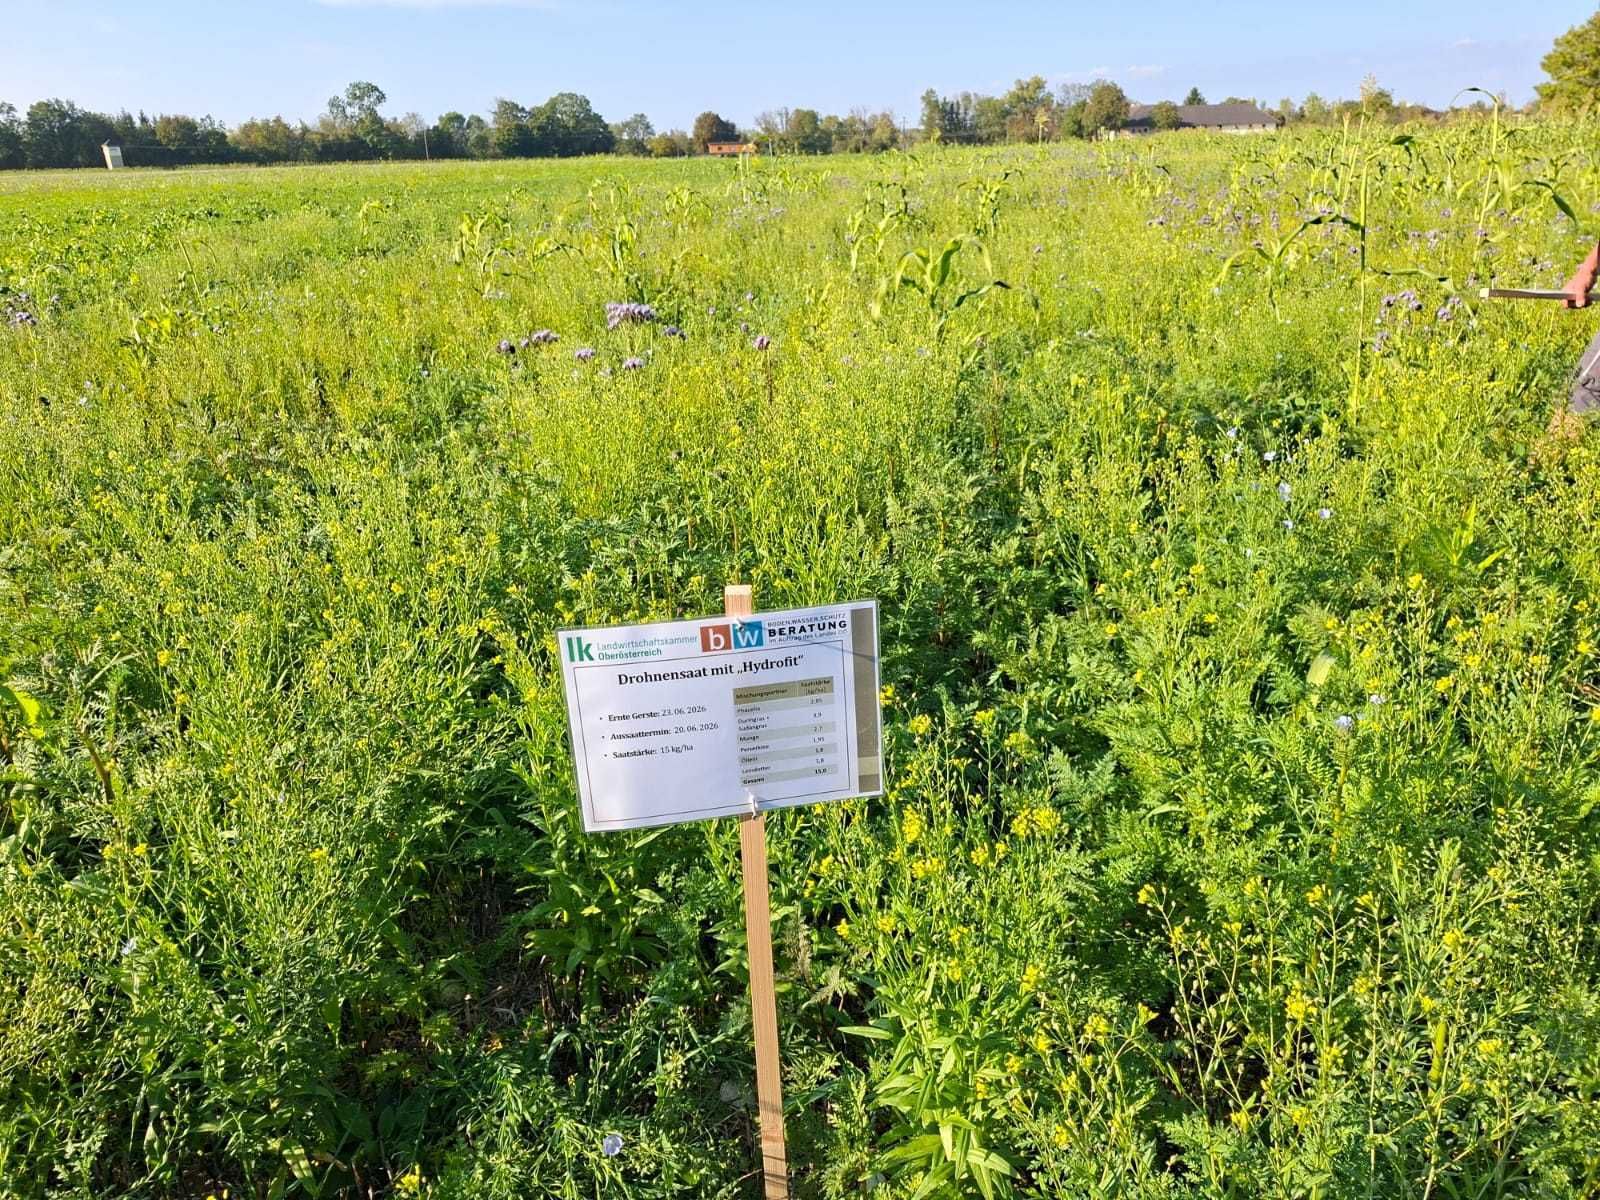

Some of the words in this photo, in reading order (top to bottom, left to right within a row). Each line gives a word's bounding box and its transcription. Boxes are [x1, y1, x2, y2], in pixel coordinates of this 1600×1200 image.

[768, 620, 847, 637] BERATUNG
[597, 635, 698, 651] Landwirtschaftskammer
[598, 648, 662, 660] Oberösterreich
[618, 667, 707, 685] Drohnensaat
[712, 664, 734, 676] mit
[632, 712, 660, 720] Gerste:
[610, 729, 671, 740] Aussaattermin:
[613, 748, 657, 759] Saatstärke:
[671, 744, 694, 754] kg/ha
